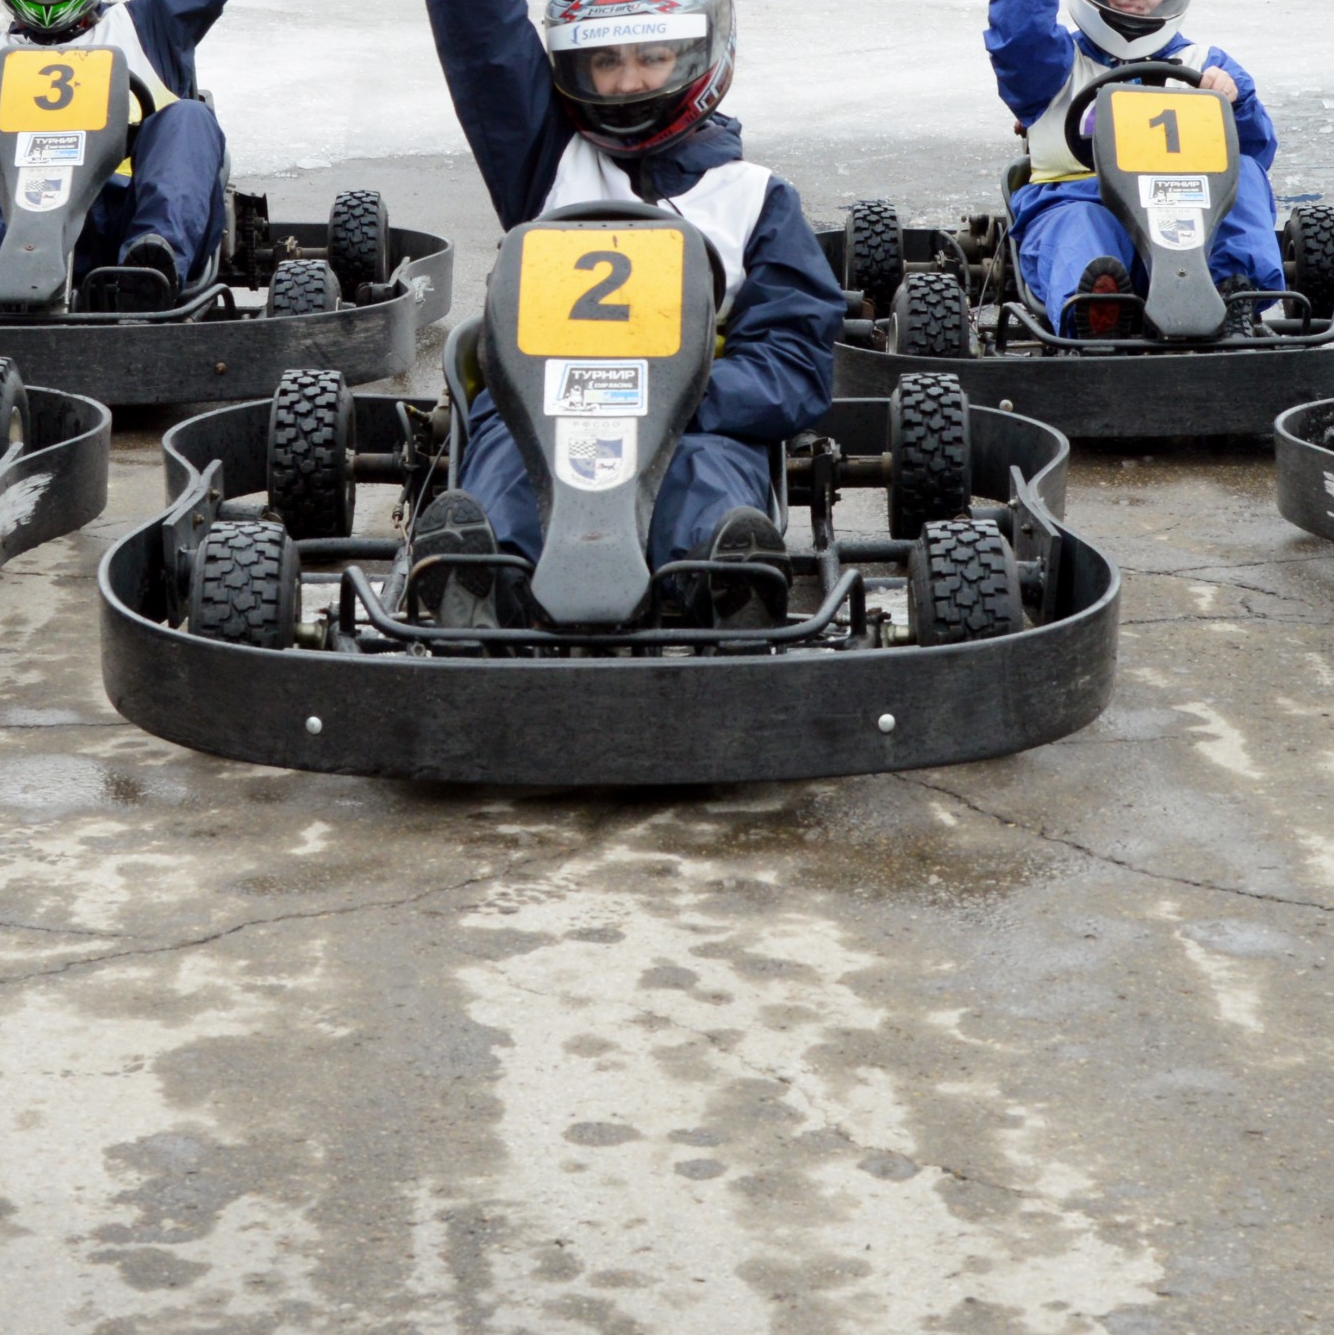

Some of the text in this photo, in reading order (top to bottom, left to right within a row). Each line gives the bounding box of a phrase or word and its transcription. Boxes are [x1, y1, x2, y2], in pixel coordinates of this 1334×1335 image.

[582, 23, 667, 41] SMP RACING
[33, 63, 75, 111] 3
[35, 137, 77, 145] ТУРНИР
[1148, 108, 1180, 154] 1
[568, 250, 634, 322] 2
[571, 370, 636, 380] ТУРНИР
